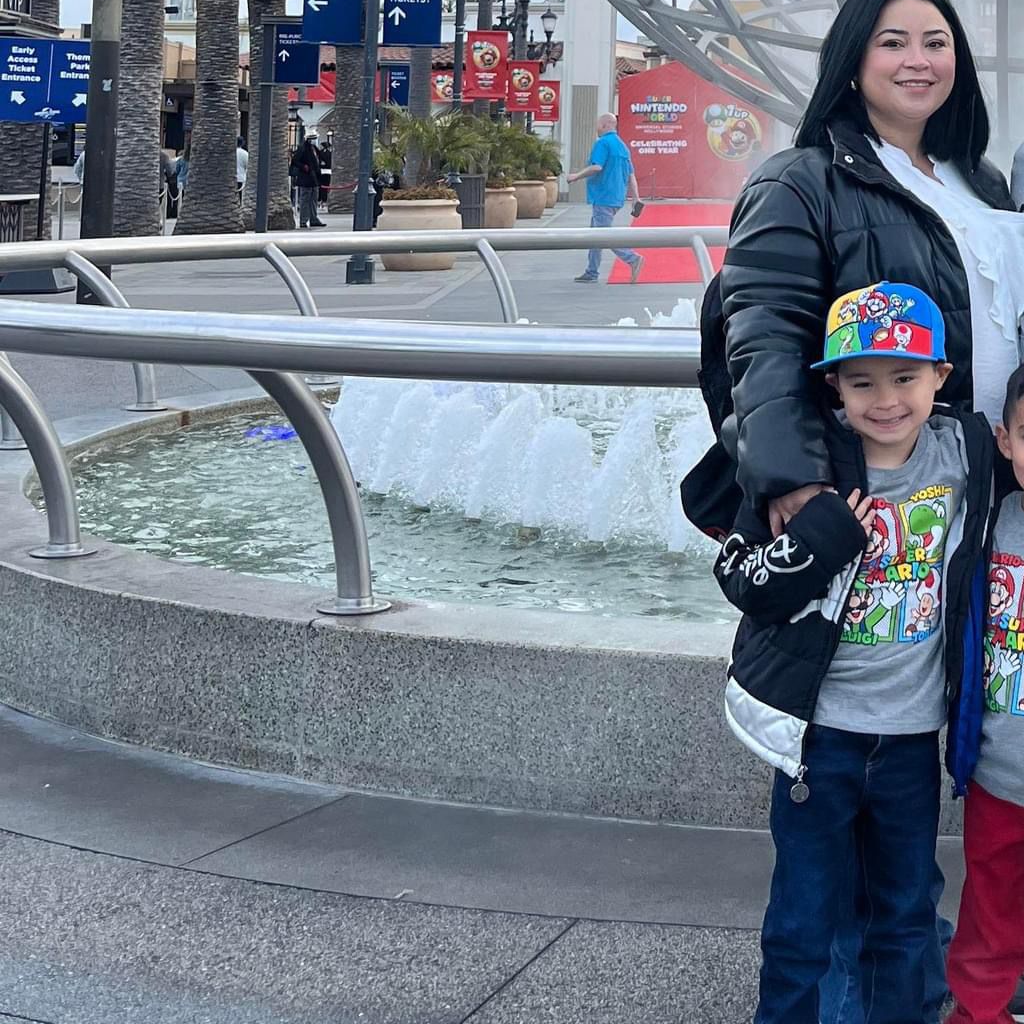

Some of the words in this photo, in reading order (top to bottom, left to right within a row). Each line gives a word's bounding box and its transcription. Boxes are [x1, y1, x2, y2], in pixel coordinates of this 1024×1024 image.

[12, 46, 35, 55] Early
[7, 55, 38, 64] Access
[66, 53, 91, 61] Them
[8, 64, 36, 73] Ticket
[70, 62, 91, 71] Park
[1, 74, 41, 82] Entrance
[60, 71, 90, 80] Entran
[630, 103, 688, 114] NINTENDO
[644, 113, 679, 122] ORLD
[630, 139, 688, 148] CELEBRATING
[910, 484, 946, 503] YOSHI
[880, 547, 927, 569] SUPER
[991, 551, 1022, 567] RIO
[865, 561, 931, 584] MARIO
